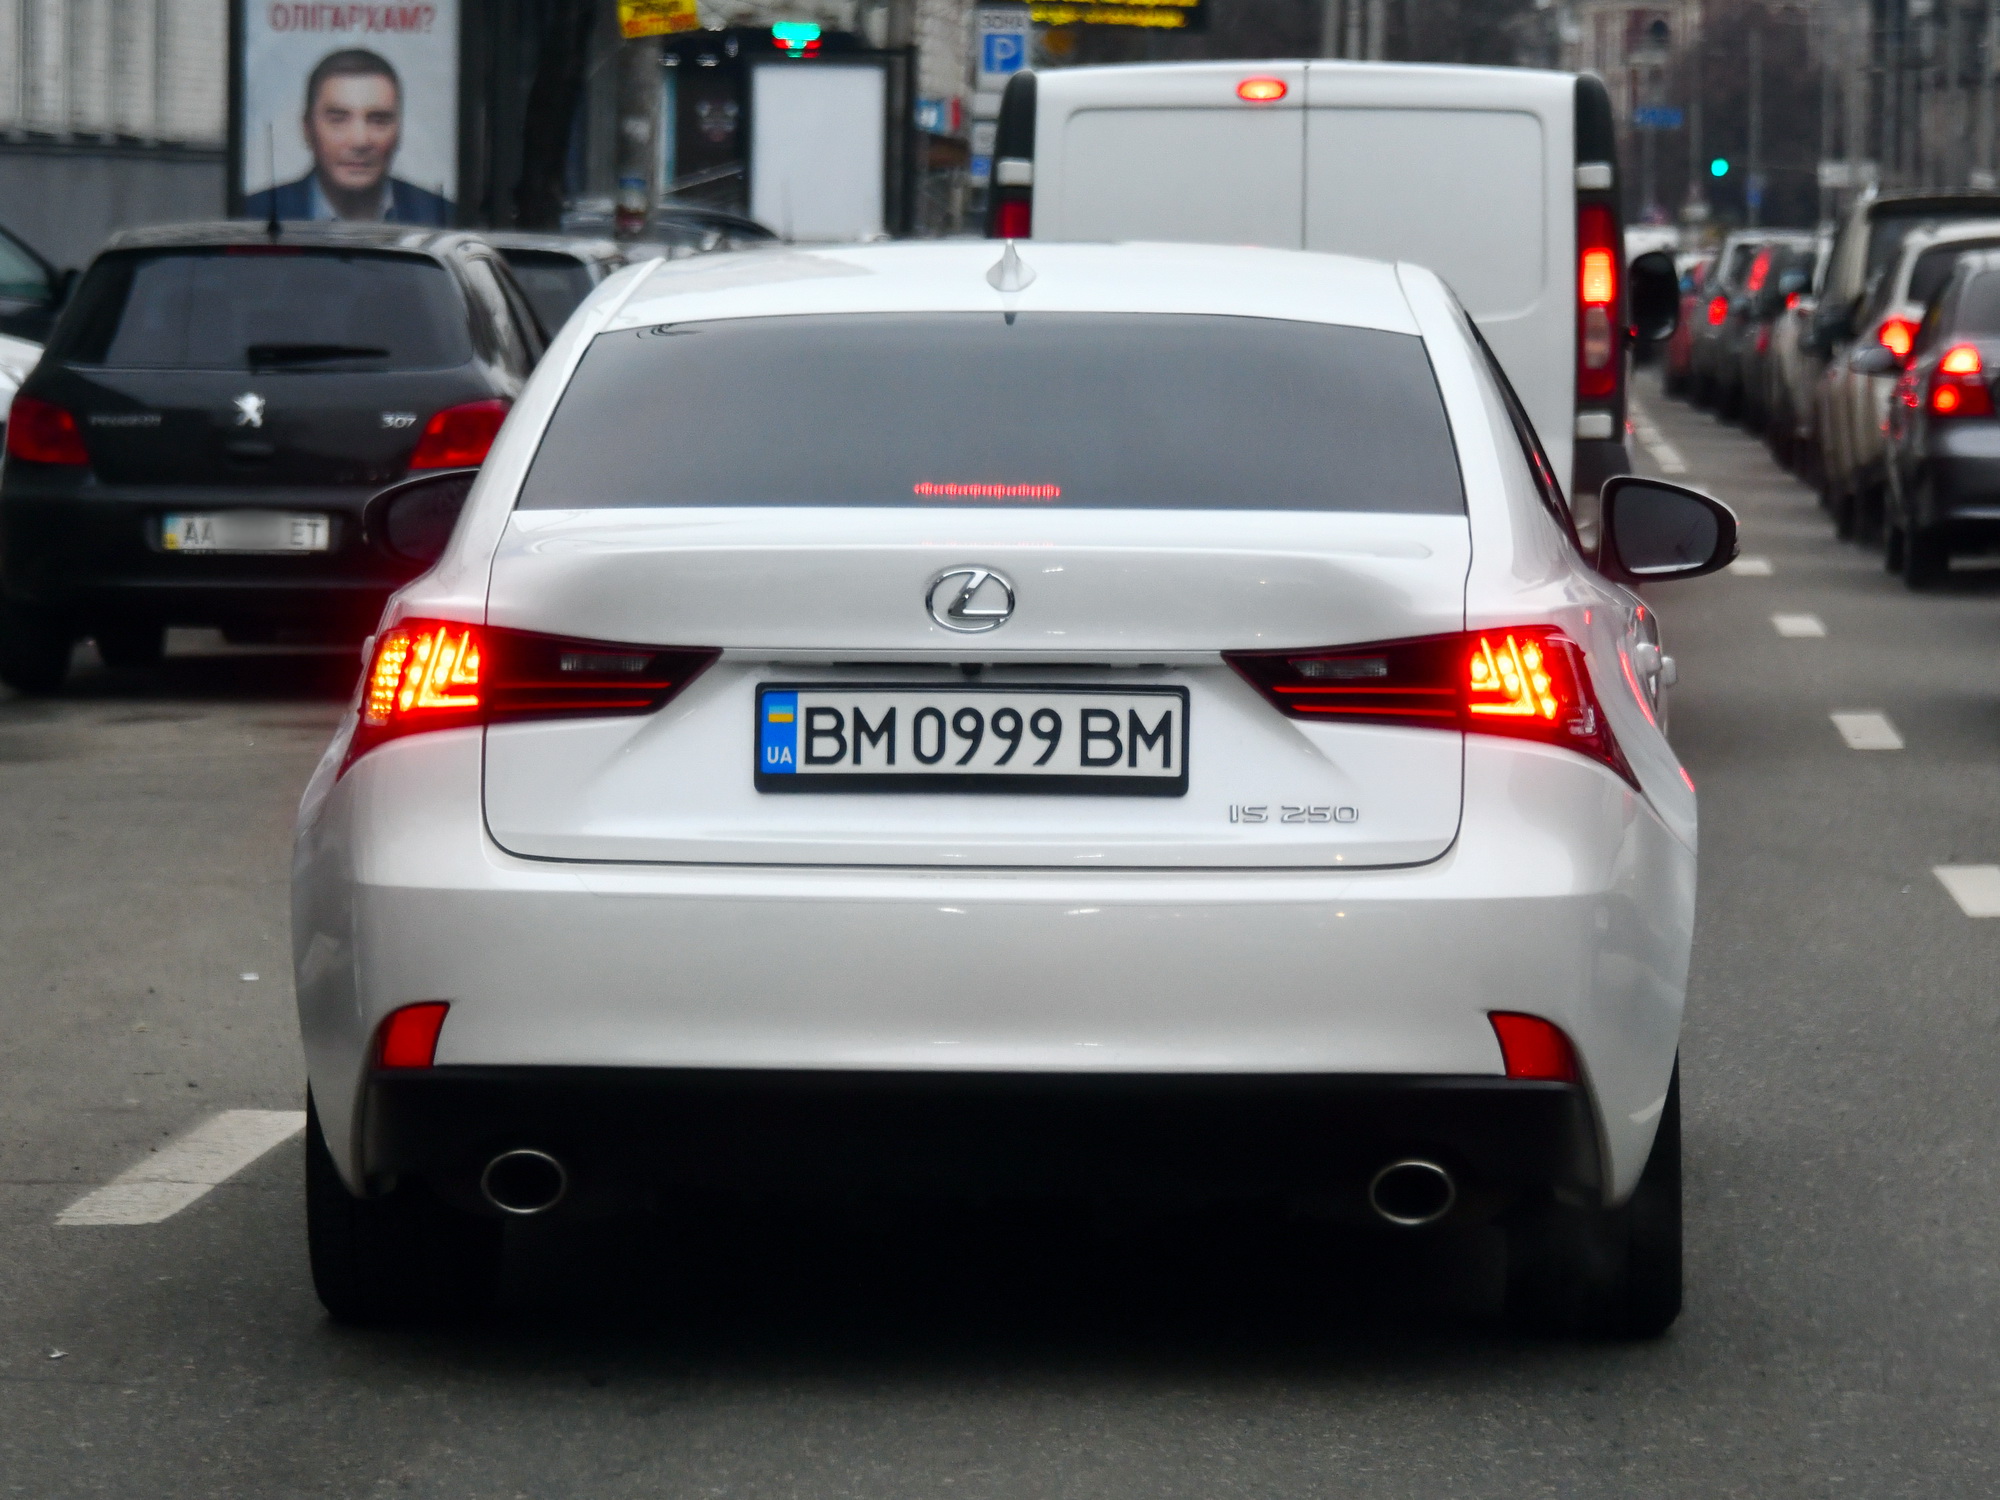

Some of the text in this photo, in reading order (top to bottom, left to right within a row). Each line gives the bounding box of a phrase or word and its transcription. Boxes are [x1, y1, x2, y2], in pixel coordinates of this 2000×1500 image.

[269, 3, 436, 33] ОЛІГАРХАМ?
[381, 412, 417, 429] 307
[183, 520, 216, 546] AA
[290, 521, 320, 546] ET
[804, 706, 1172, 769] BM 0999 BM
[767, 746, 792, 764] UA
[1229, 805, 1359, 823] IS 250
